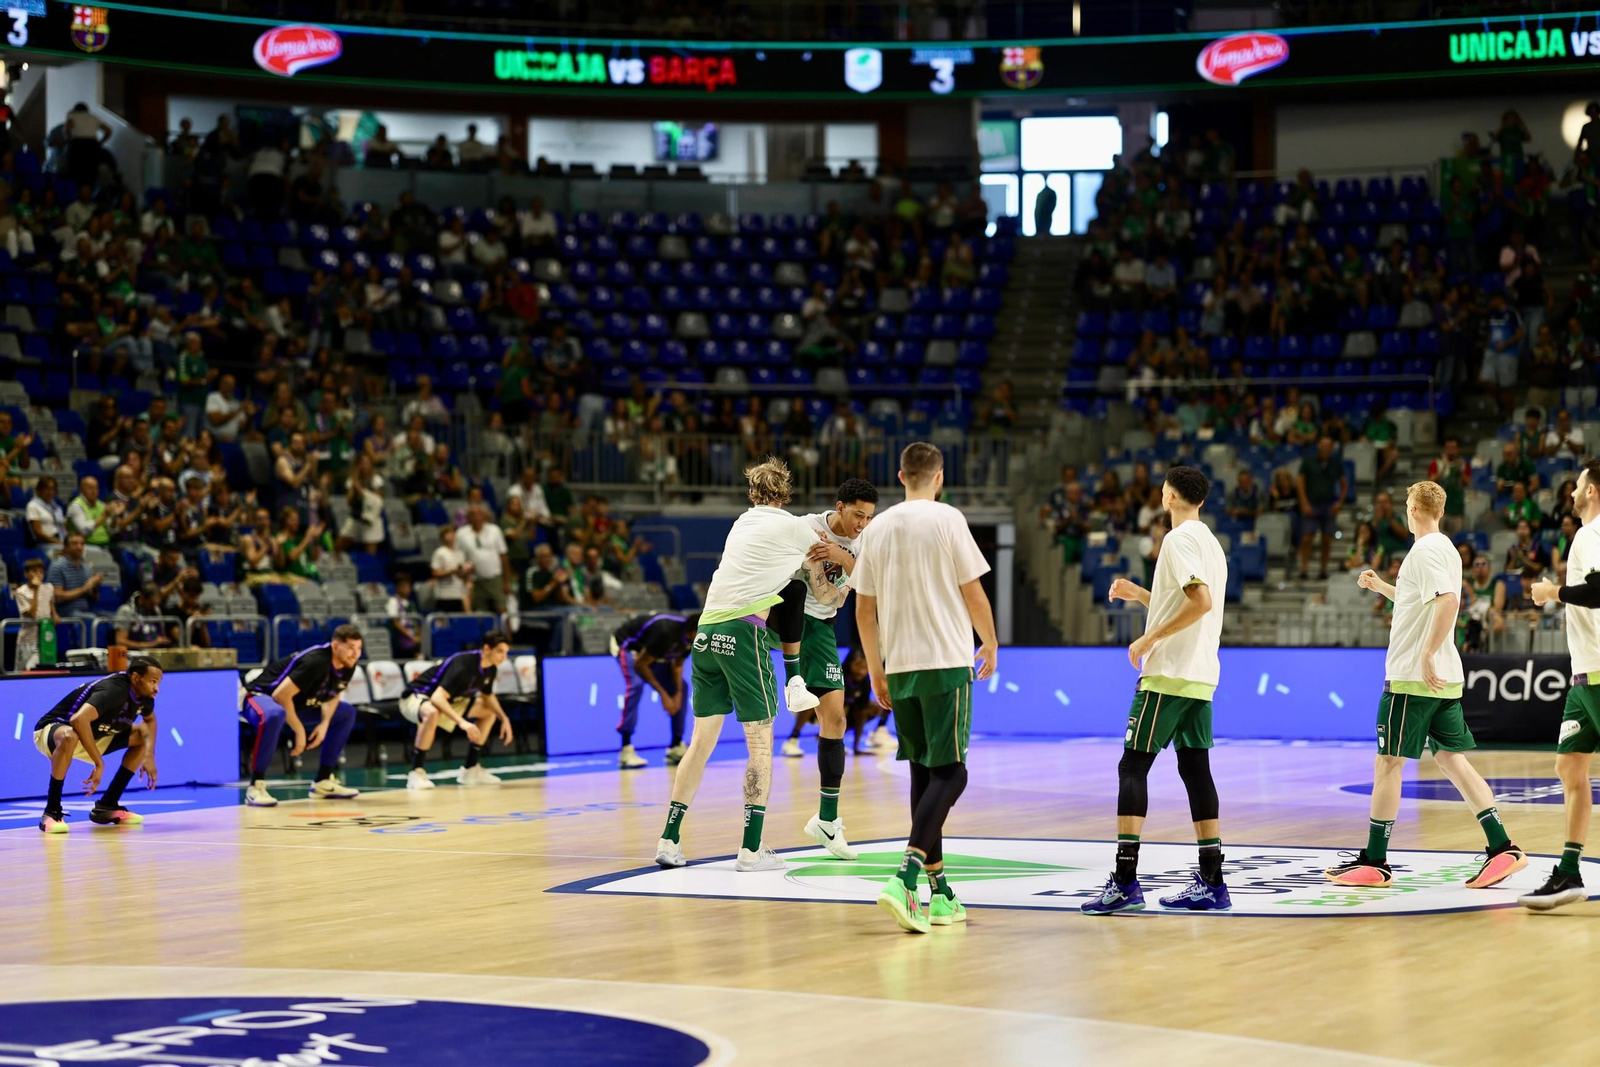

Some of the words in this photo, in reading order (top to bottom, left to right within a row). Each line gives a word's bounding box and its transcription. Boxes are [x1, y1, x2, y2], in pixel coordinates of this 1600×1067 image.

[7, 8, 28, 47] 3
[1449, 28, 1566, 63] UNICAJA
[650, 55, 737, 92] BARÇA
[929, 58, 955, 95] 3
[710, 640, 721, 648] DEL
[722, 642, 736, 651] SOL
[711, 633, 737, 644] COSTA
[1462, 659, 1574, 702] nde
[1272, 861, 1485, 907] Baloncest
